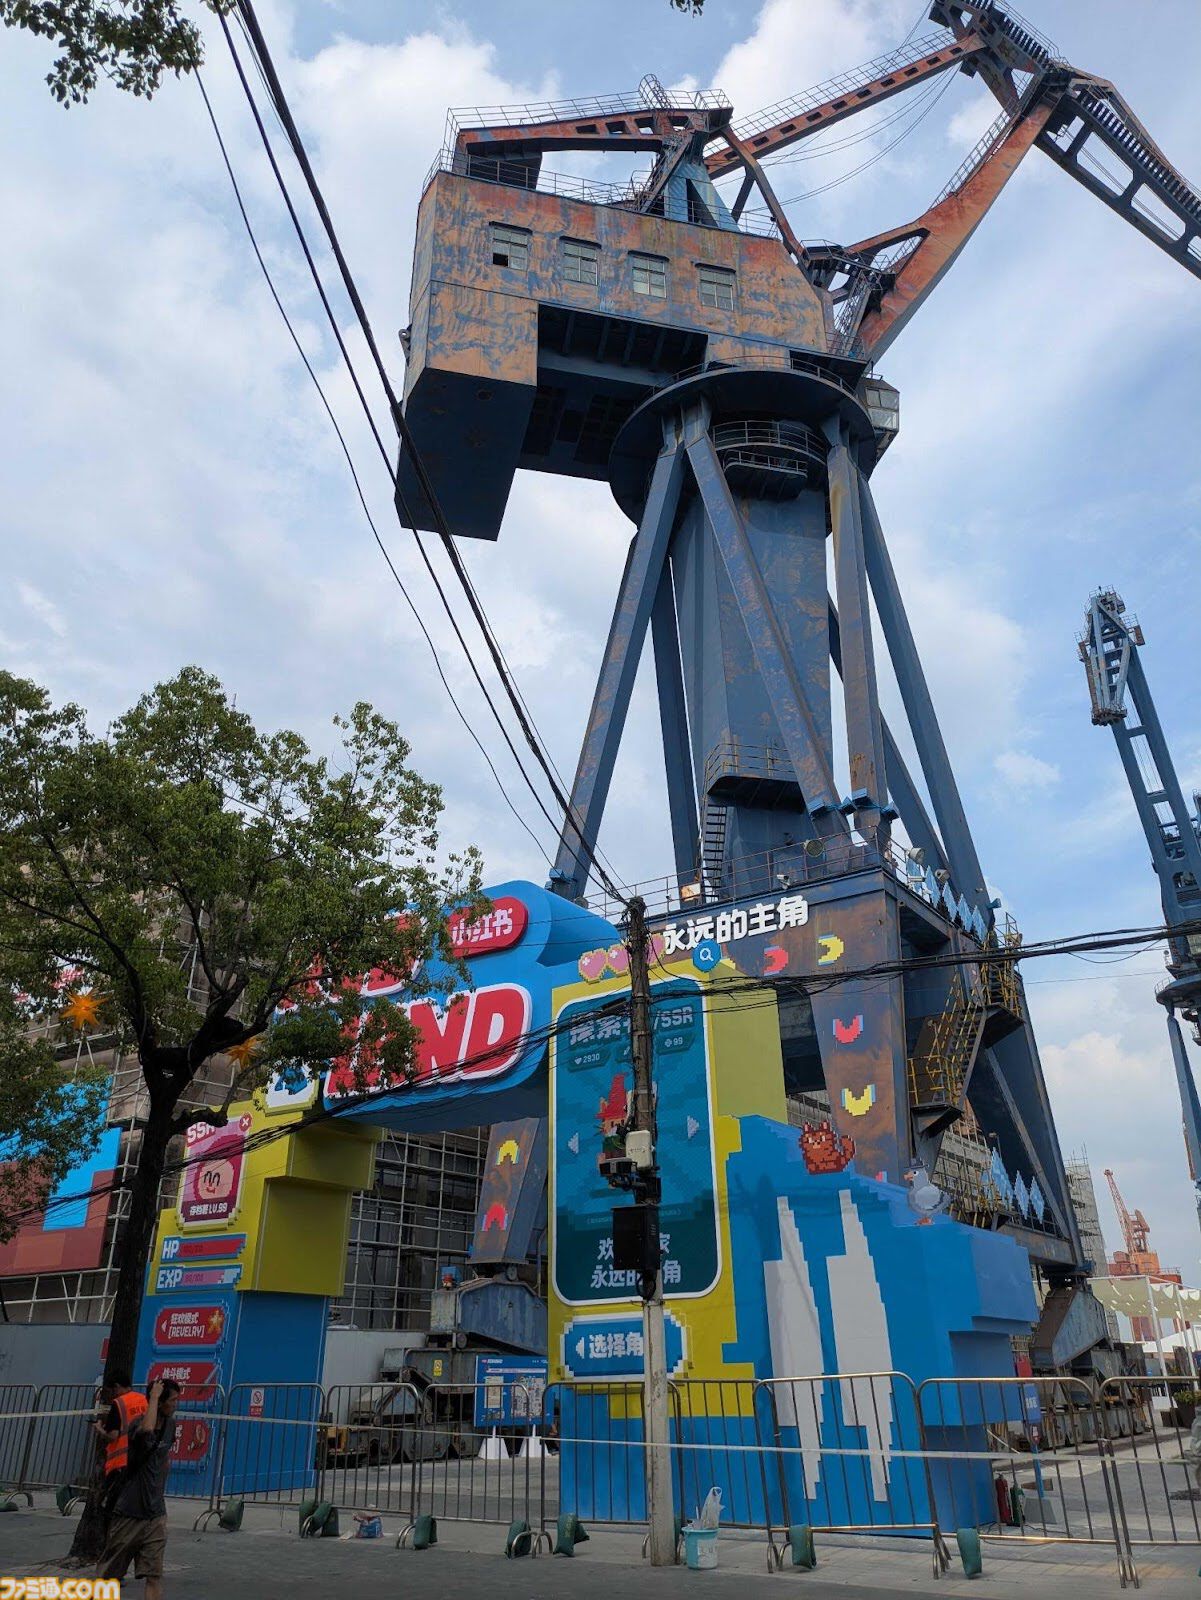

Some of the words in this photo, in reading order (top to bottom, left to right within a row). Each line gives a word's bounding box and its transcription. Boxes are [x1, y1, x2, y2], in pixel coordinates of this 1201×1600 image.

[451, 908, 513, 946] 小红书
[664, 895, 809, 955] 永远的主角
[162, 1240, 180, 1260] HP
[157, 1268, 182, 1289] EXP
[590, 1259, 682, 1289] 永远的角
[588, 1331, 645, 1358] 选择角
